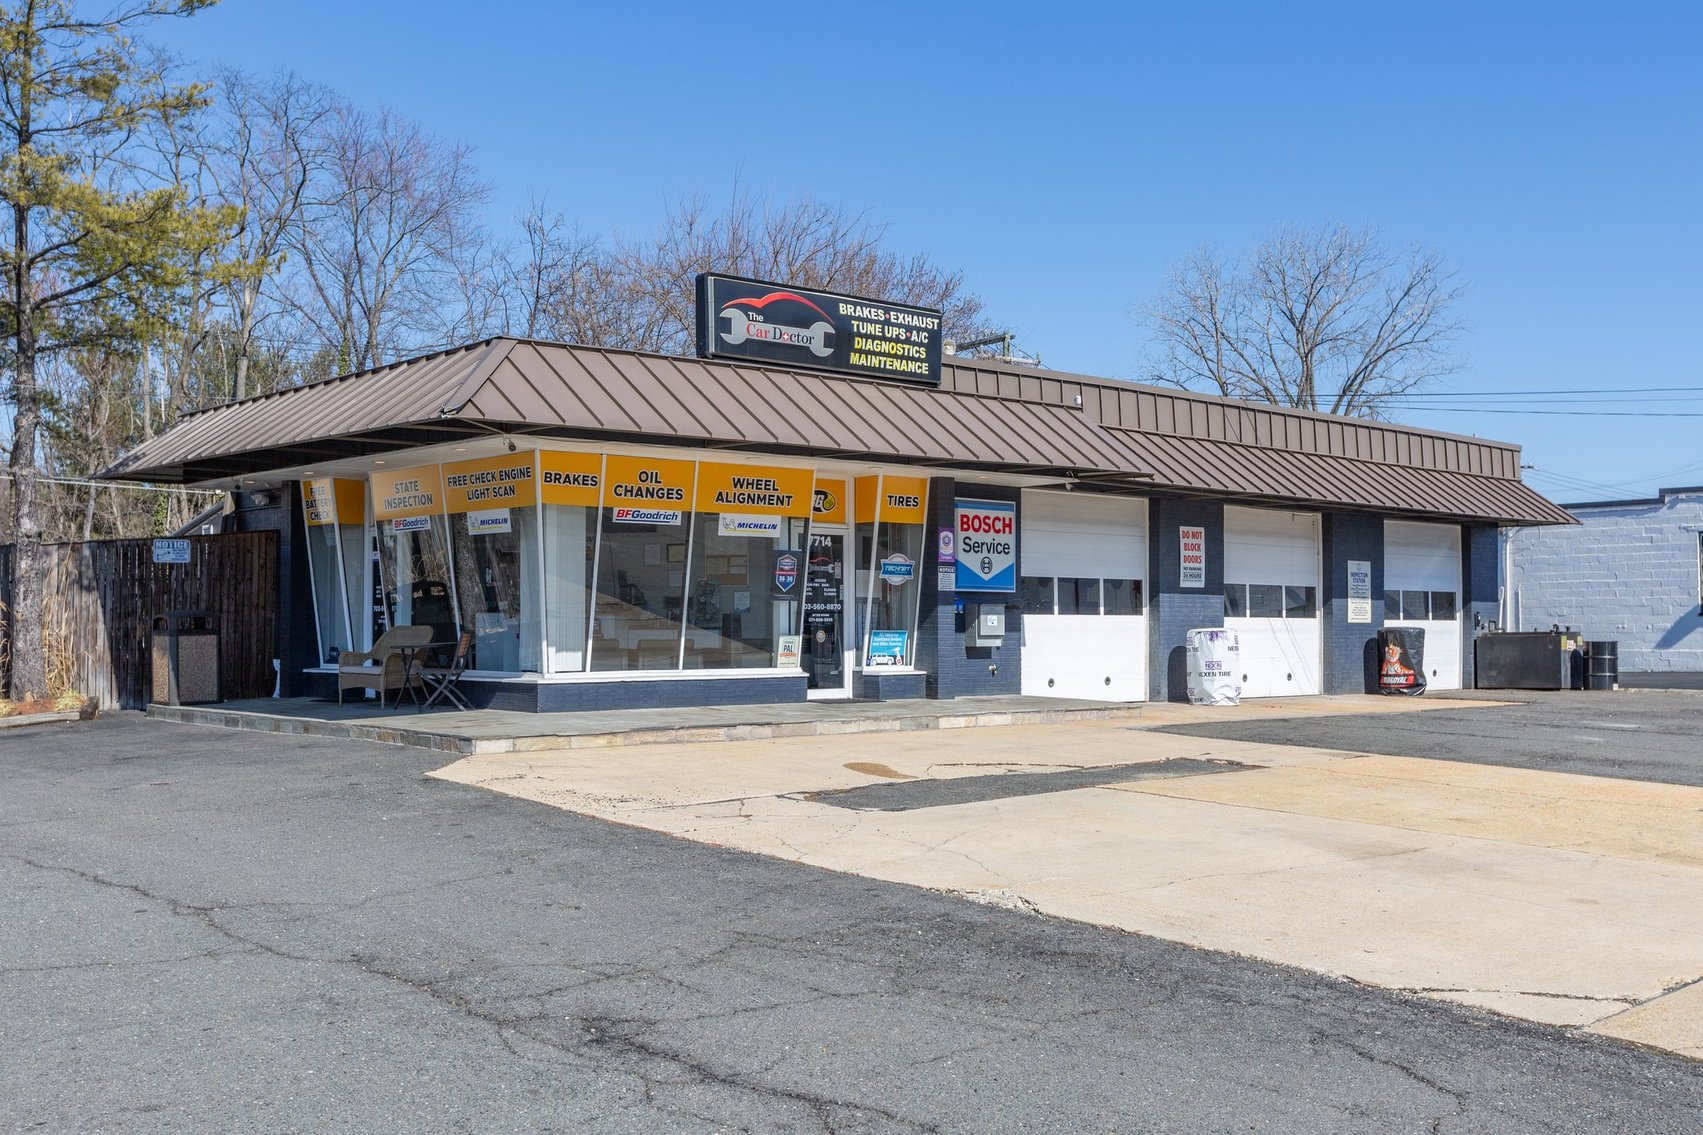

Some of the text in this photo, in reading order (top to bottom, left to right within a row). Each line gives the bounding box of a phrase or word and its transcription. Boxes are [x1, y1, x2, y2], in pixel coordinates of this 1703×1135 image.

[747, 311, 764, 321] The
[839, 303, 940, 330] BRAKES EXHAUST
[746, 322, 815, 345] Car Doctor
[851, 320, 929, 343] TUNE UPS A/C
[854, 337, 926, 358] DIAGNOSTICS
[849, 352, 929, 374] MAINTENANCE
[447, 466, 532, 487] FREE CHECK ENGINE
[543, 472, 598, 487] BRAKES
[638, 470, 662, 484] OIL
[394, 480, 419, 494] STATE
[732, 477, 779, 491] WHEEL
[310, 486, 325, 497] FREE
[466, 485, 515, 500] LIGHT SCAN
[613, 484, 684, 500] CHANGES
[305, 496, 332, 509] BATTERY
[384, 493, 433, 510] INSPECTION
[715, 491, 793, 507] ALIGNMENT
[887, 495, 919, 508] TIRES
[310, 511, 328, 521] CHECK
[480, 517, 508, 526] MICHELIN
[616, 509, 679, 521] BFGoodrich
[394, 517, 429, 529] BFGoodrich
[737, 522, 778, 530] MICHELIN
[960, 514, 1013, 535] BOSCH
[1182, 530, 1202, 540] DO NOT
[155, 541, 189, 549] NOTICE
[962, 536, 1011, 555] Service
[1183, 543, 1201, 552] BLOCK
[1183, 555, 1202, 564] DOORS
